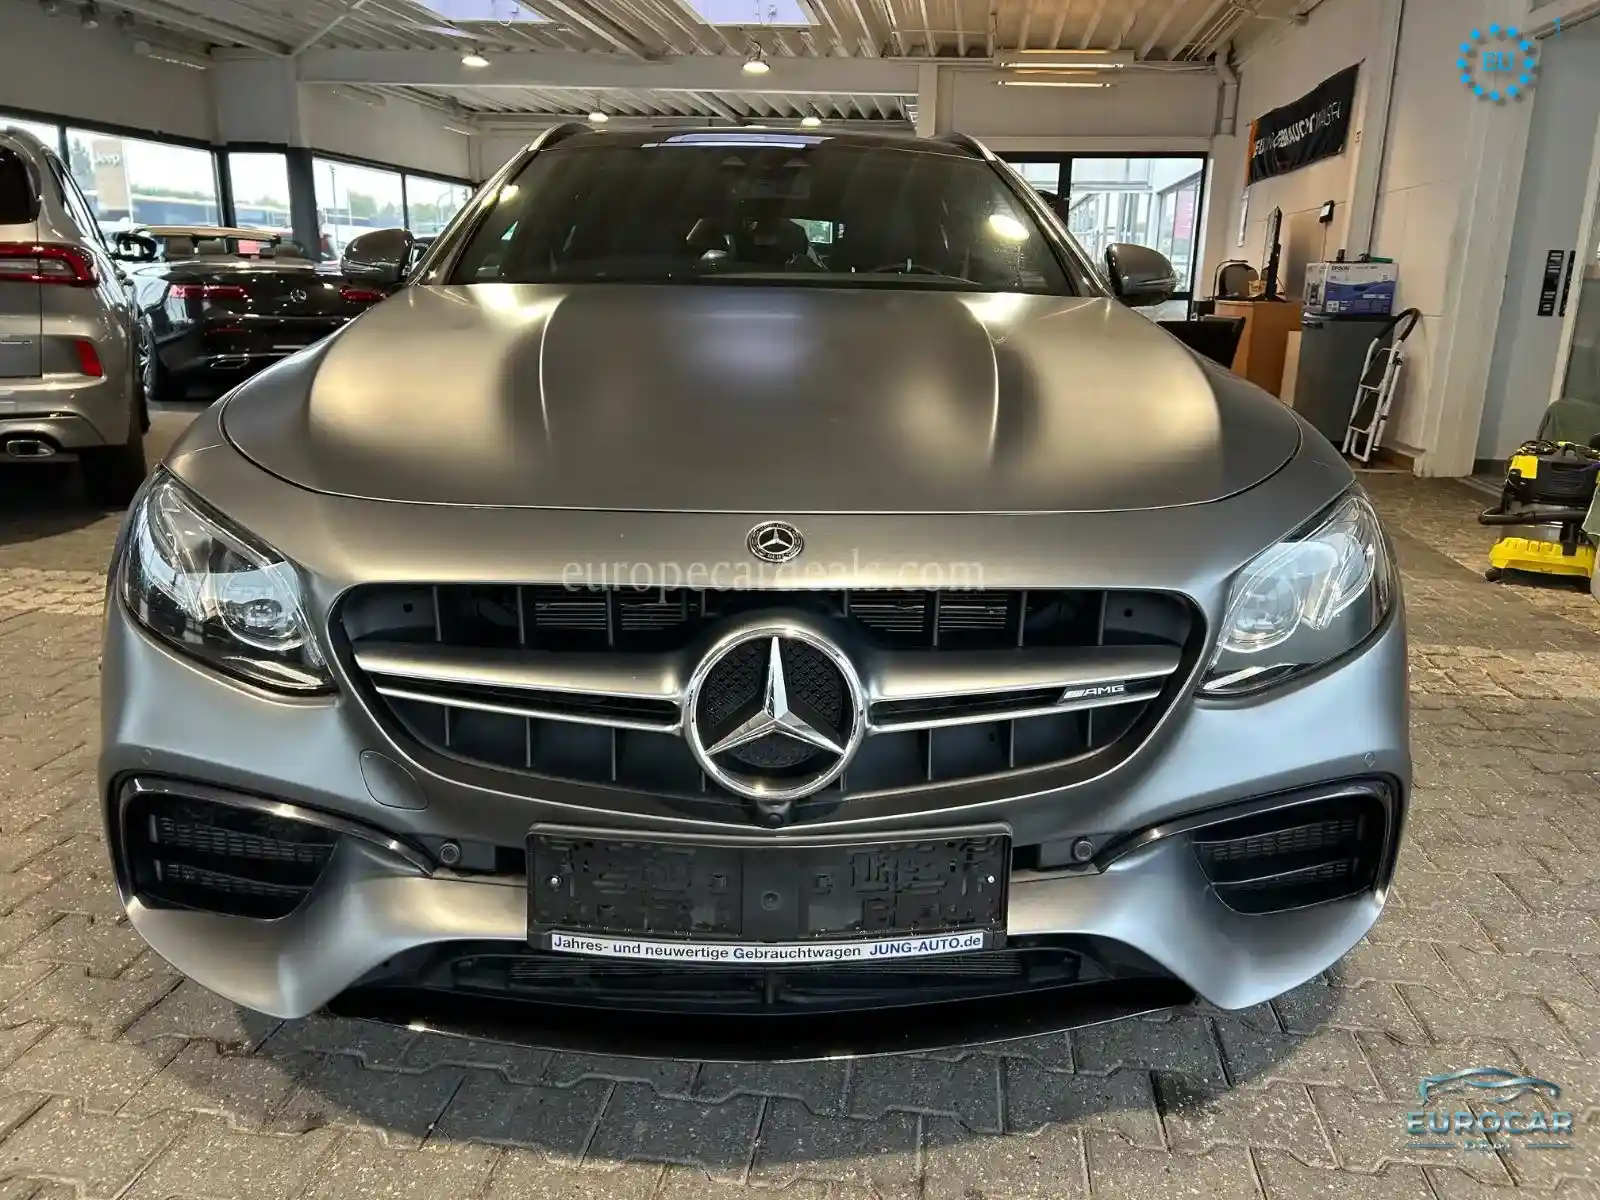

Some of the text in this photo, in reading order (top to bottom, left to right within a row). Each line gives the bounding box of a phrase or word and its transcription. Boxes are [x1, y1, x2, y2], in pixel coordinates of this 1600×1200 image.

[1083, 684, 1125, 697] AMG
[554, 935, 981, 960] Jahres- und neuwertige Gebrauchtwagen JUNG-AUTO.de
